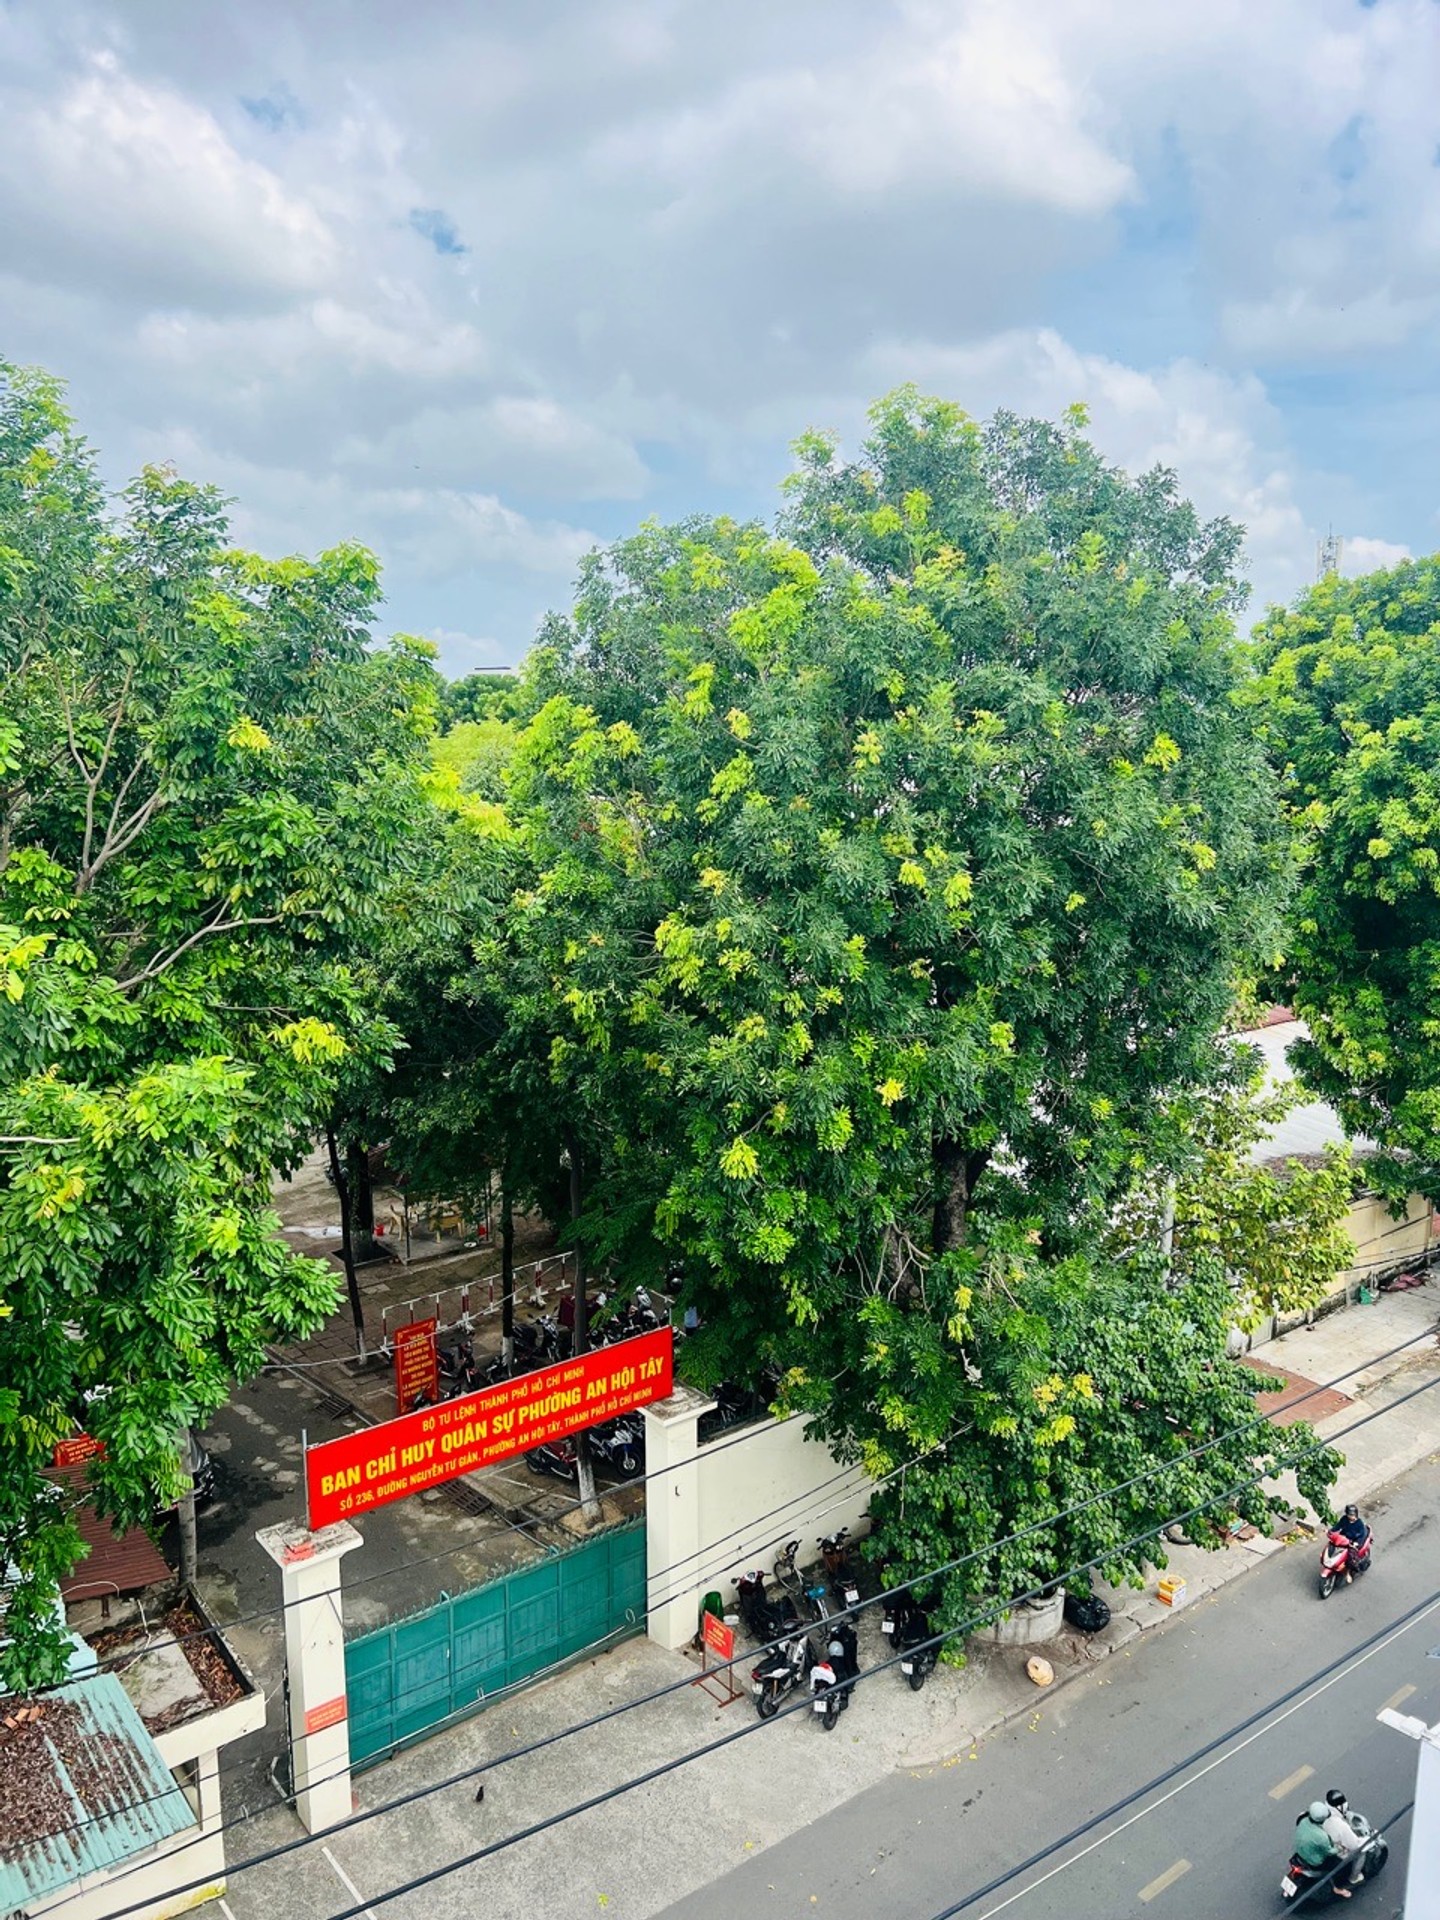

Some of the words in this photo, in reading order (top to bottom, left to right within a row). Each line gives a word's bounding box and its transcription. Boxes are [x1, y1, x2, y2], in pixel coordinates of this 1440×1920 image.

[321, 1465, 361, 1496] BAN
[366, 1446, 396, 1480] CHỈ
[401, 1439, 435, 1468] HUY
[441, 1421, 487, 1453] QUÂN
[492, 1408, 515, 1434] SỰ
[518, 1387, 581, 1425] PHƯỜNG
[586, 1377, 607, 1400] AN
[611, 1366, 635, 1391] HỘI
[639, 1356, 664, 1380] TÂY
[423, 1416, 435, 1431] BỘ
[439, 1411, 451, 1426] TƯ
[454, 1403, 476, 1421] LỆNH
[480, 1392, 508, 1411] THÀNH
[512, 1382, 528, 1400] PHỐ
[531, 1377, 543, 1393] HỒ
[546, 1372, 560, 1388] CHÍ
[563, 1365, 585, 1382] MINH
[340, 1493, 353, 1511] SỐ
[518, 1432, 529, 1445] AN
